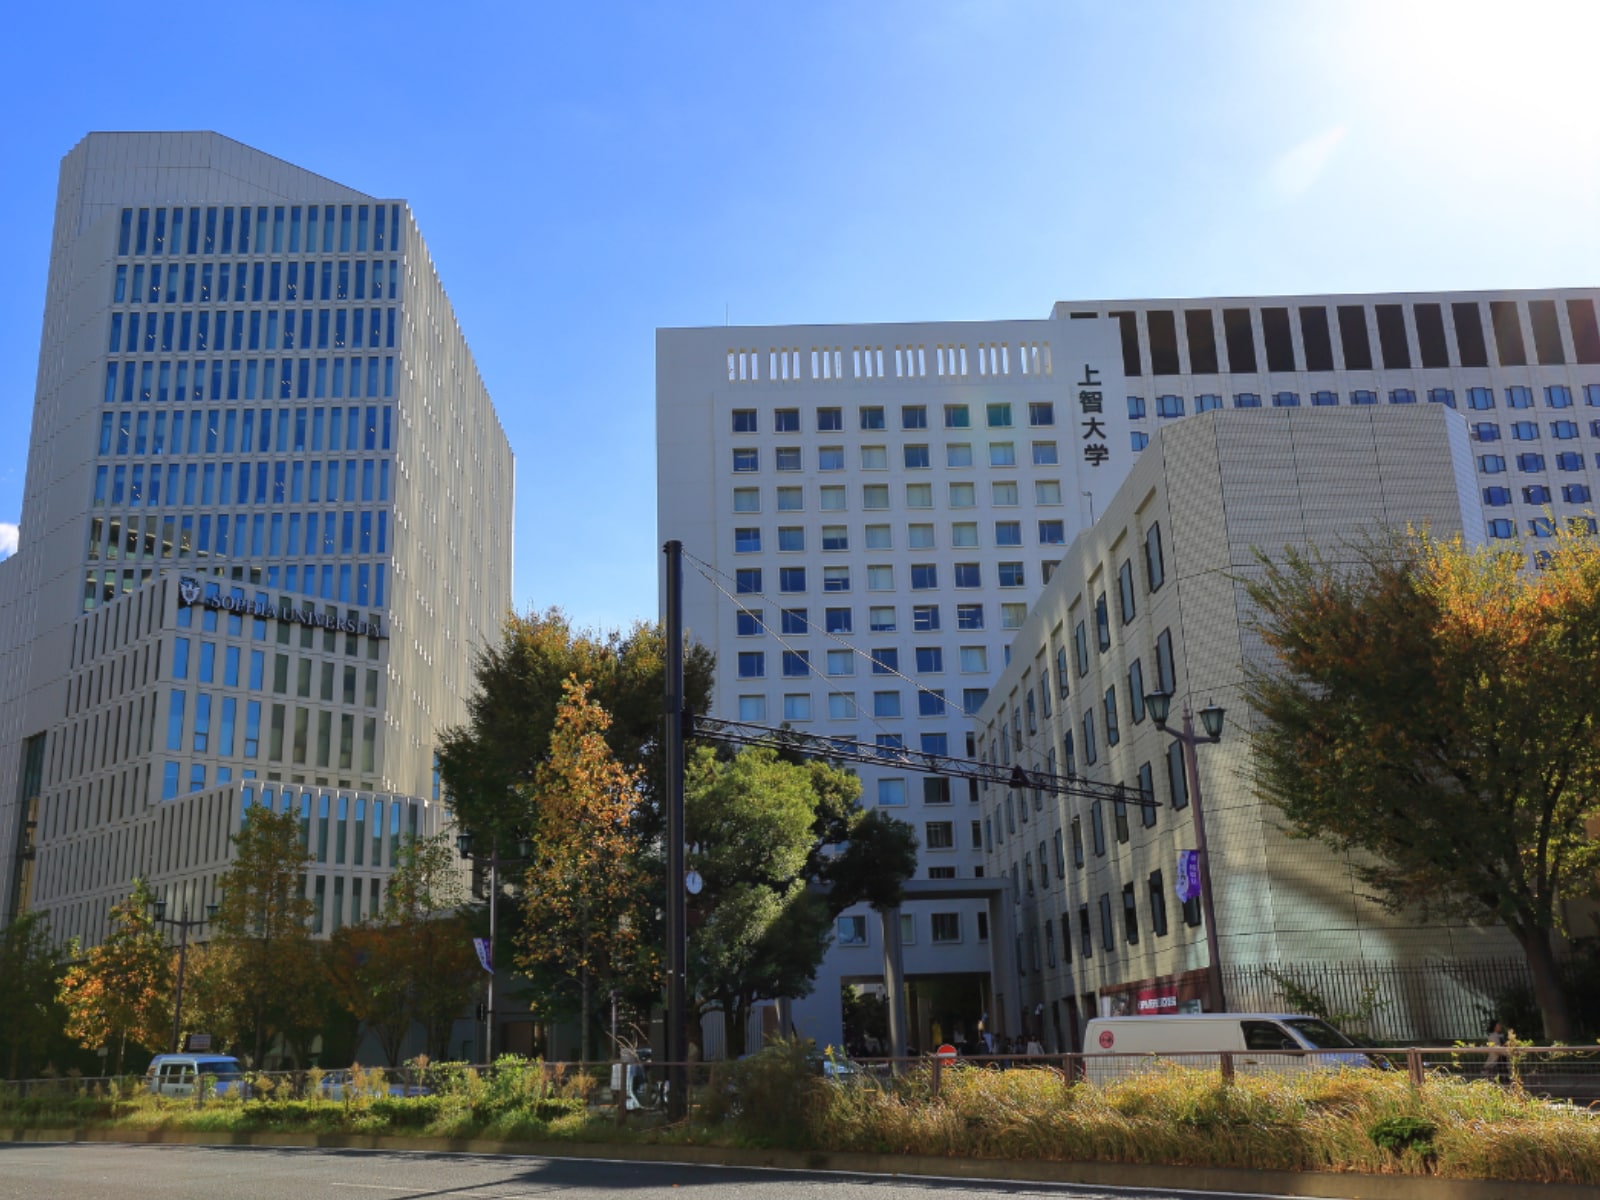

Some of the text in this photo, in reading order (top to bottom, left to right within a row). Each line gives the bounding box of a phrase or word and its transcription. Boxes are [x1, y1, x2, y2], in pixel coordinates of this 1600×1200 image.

[1077, 364, 1109, 466] 上智大学
[210, 594, 381, 638] SOPHIA UNIVERSITY
